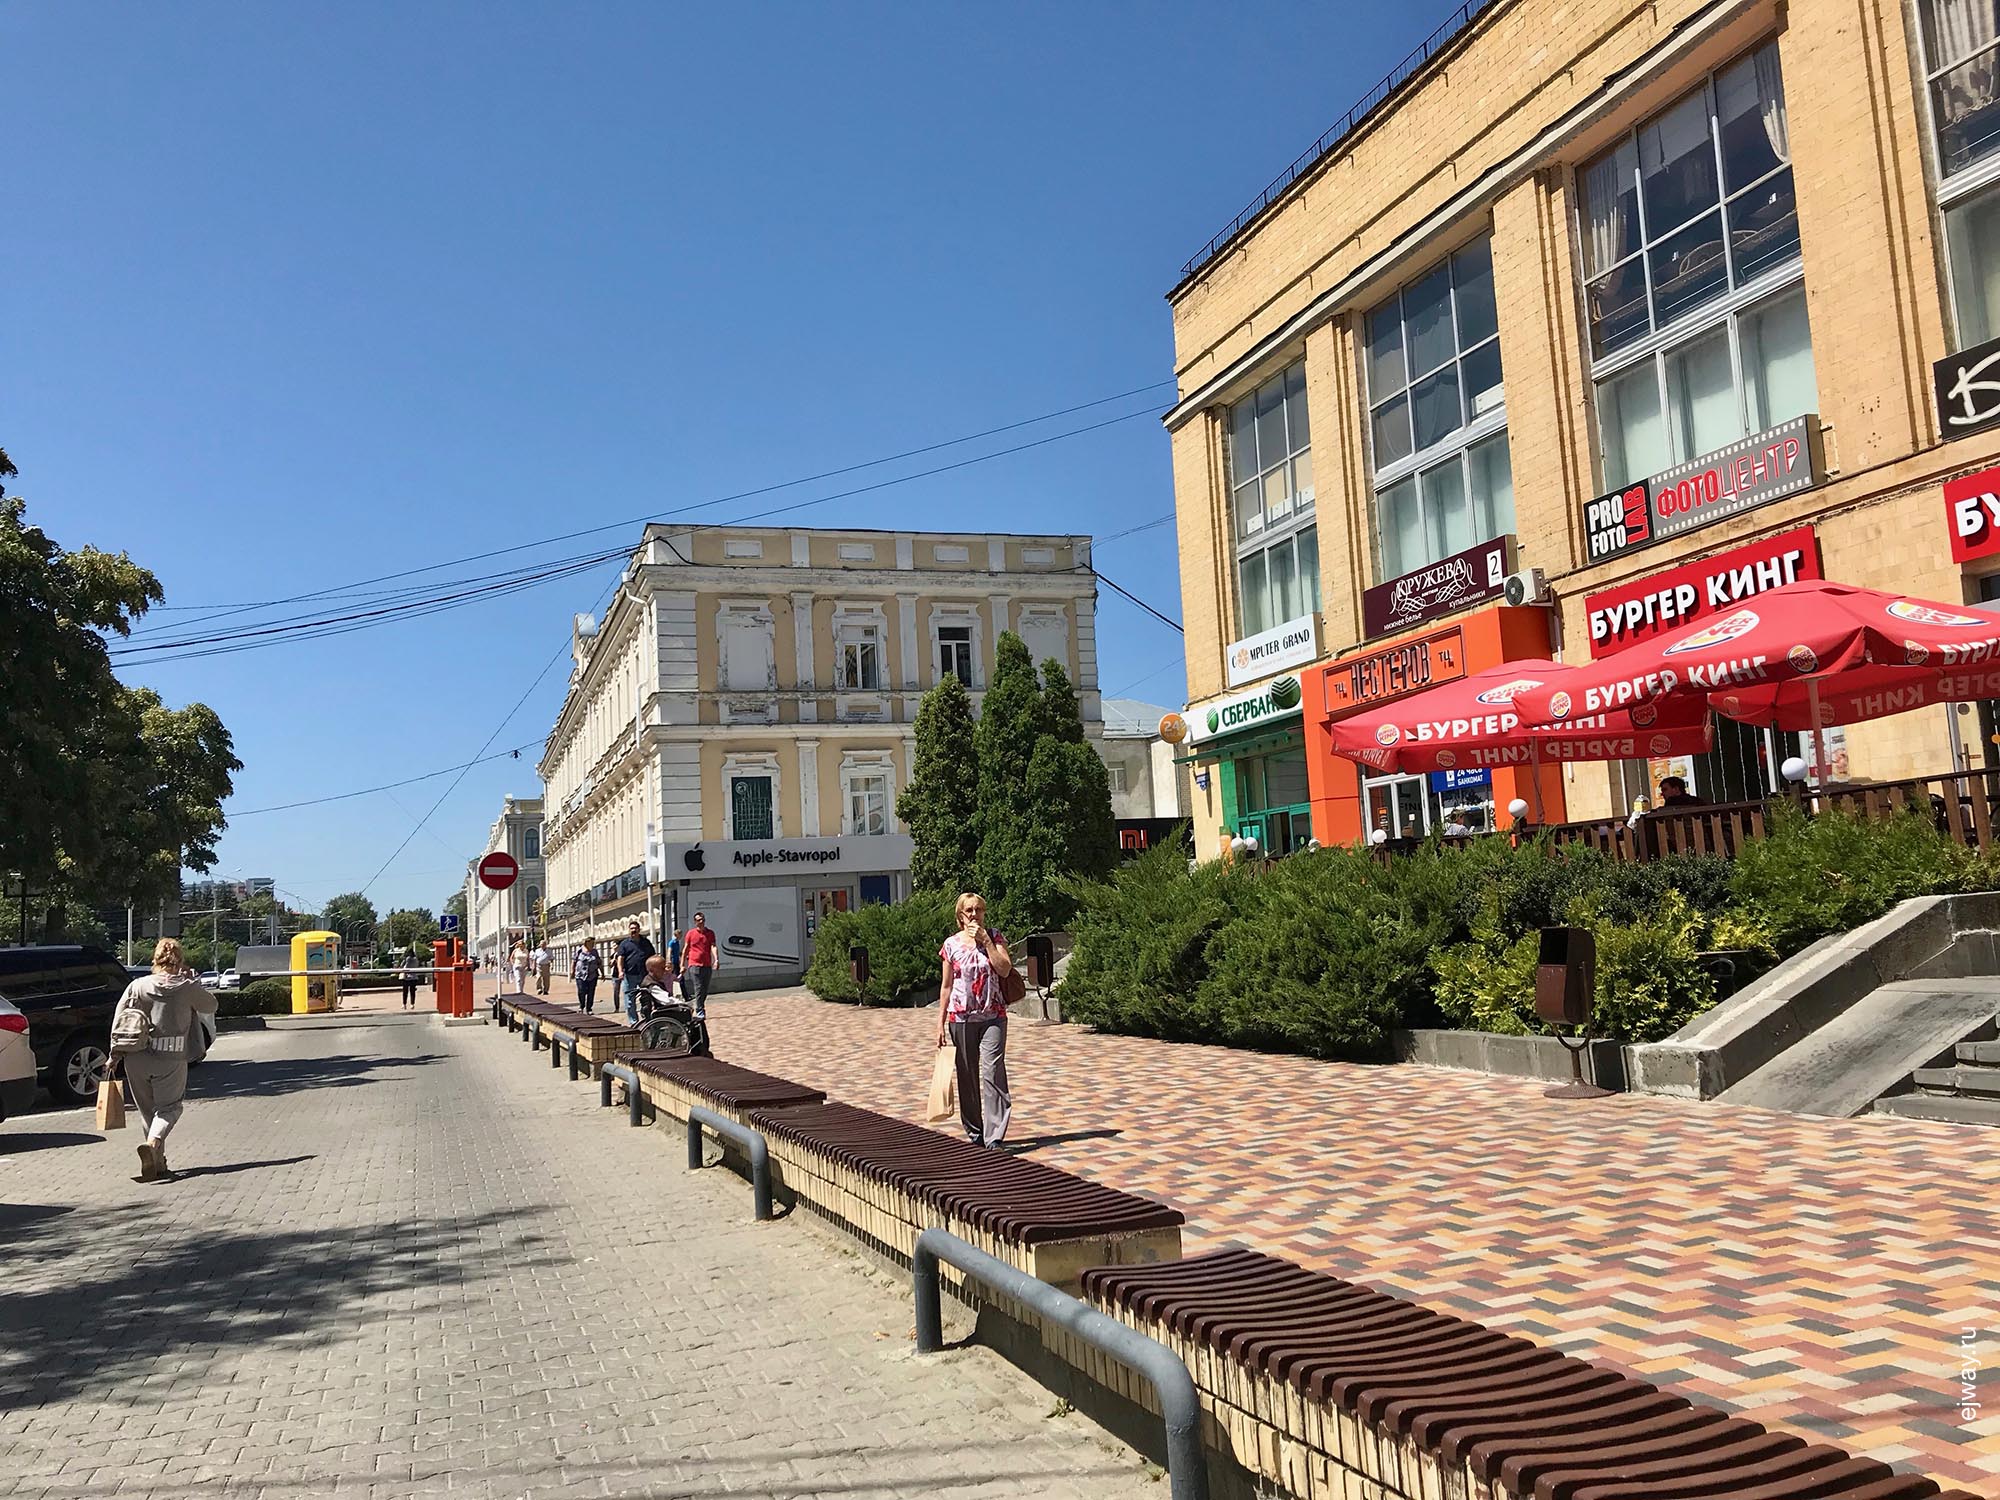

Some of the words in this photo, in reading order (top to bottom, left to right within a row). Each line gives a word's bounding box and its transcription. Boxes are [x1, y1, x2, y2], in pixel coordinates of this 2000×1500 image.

[1657, 438, 1799, 519] ФОТОЦЕНТР
[1588, 494, 1624, 532] PRO
[1623, 485, 1649, 545] LAB
[1591, 525, 1626, 557] FOTO
[1395, 560, 1466, 598] КРУЖЕВА
[1490, 555, 1499, 576] 2
[1449, 590, 1486, 609] купальники
[1590, 584, 1695, 640] БУРГЕР
[1706, 550, 1800, 606] КИНГ
[1384, 617, 1405, 631] нижнее
[1405, 612, 1423, 624] белье
[1283, 629, 1310, 650] GRAND
[1936, 637, 2000, 665] БУРГ
[1351, 642, 1431, 701] НЕСТЕРОВ
[1585, 670, 1678, 711] БУРГЕР
[1687, 655, 1767, 688] КИНГ
[1222, 693, 1280, 728] СБЕРБАН
[1416, 713, 1519, 741] БУРГЕР
[733, 847, 841, 867] Apple-Stavropol
